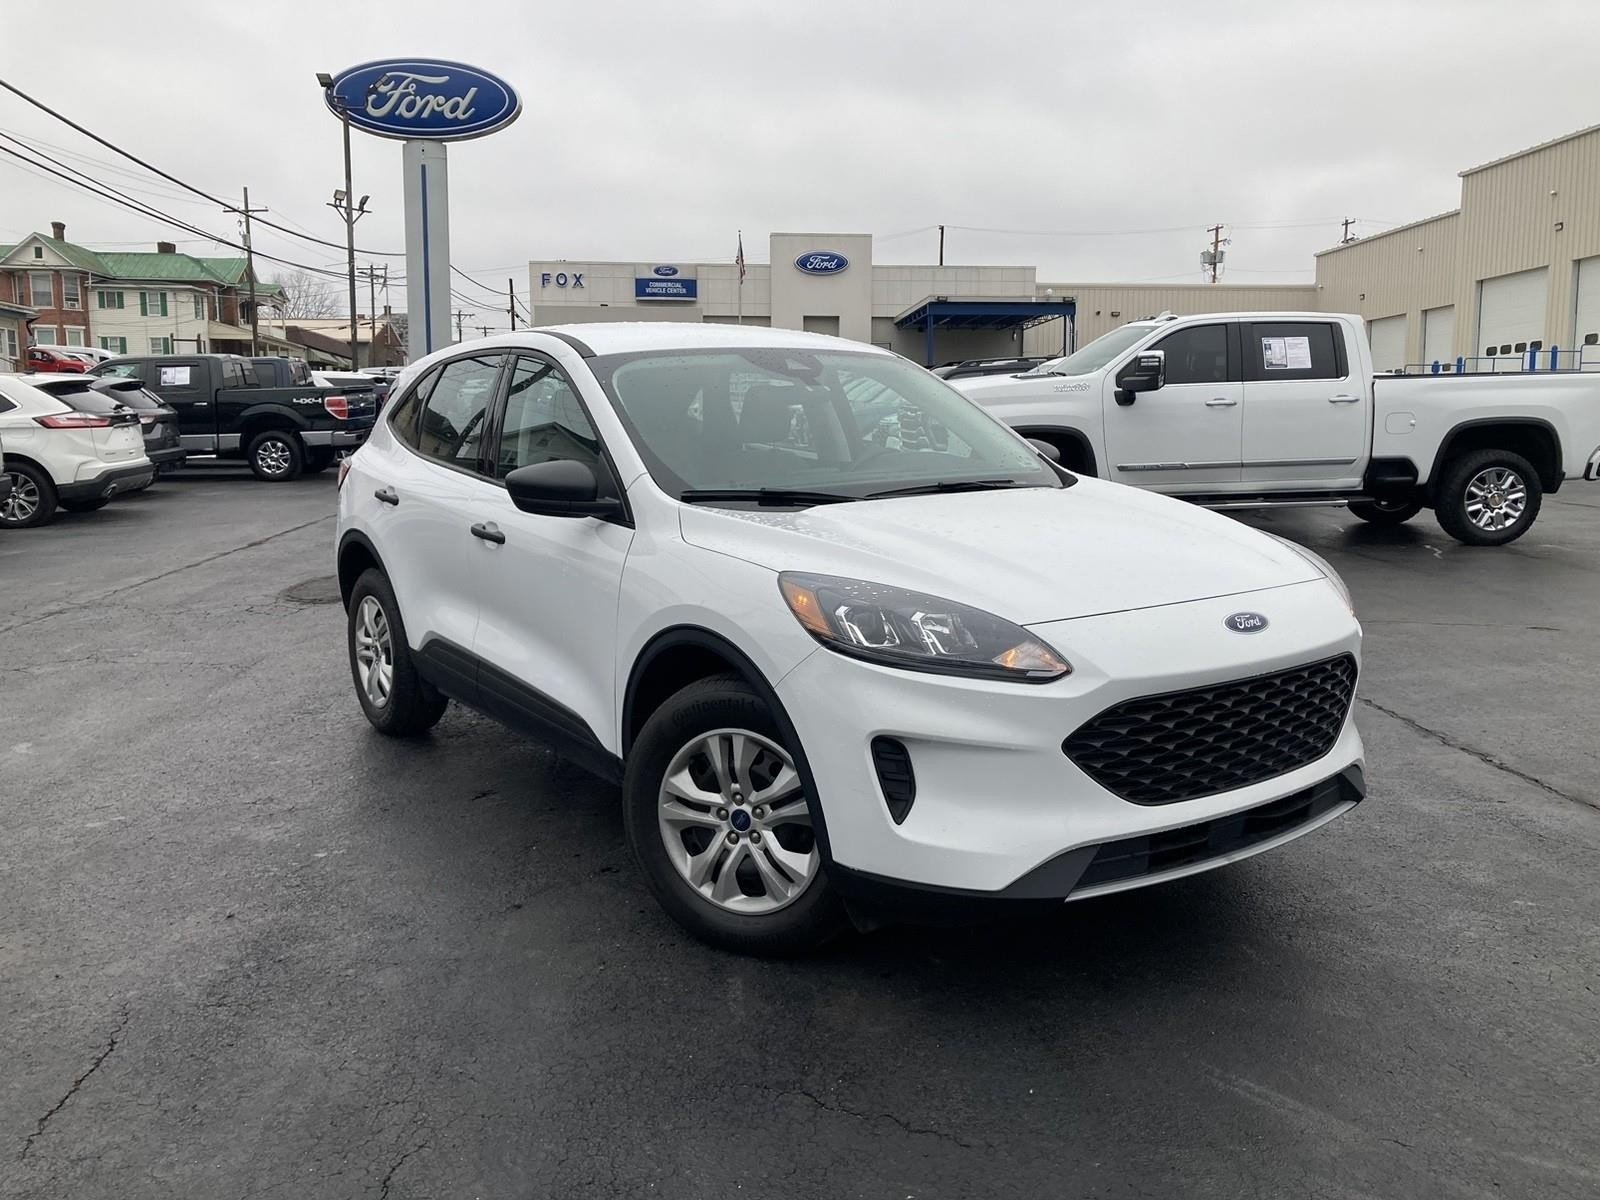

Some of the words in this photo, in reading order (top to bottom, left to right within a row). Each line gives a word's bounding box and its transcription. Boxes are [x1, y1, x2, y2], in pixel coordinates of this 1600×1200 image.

[366, 71, 477, 119] Ford
[807, 255, 837, 269] Ford
[541, 273, 584, 287] FOX
[1235, 614, 1261, 629] Ford
